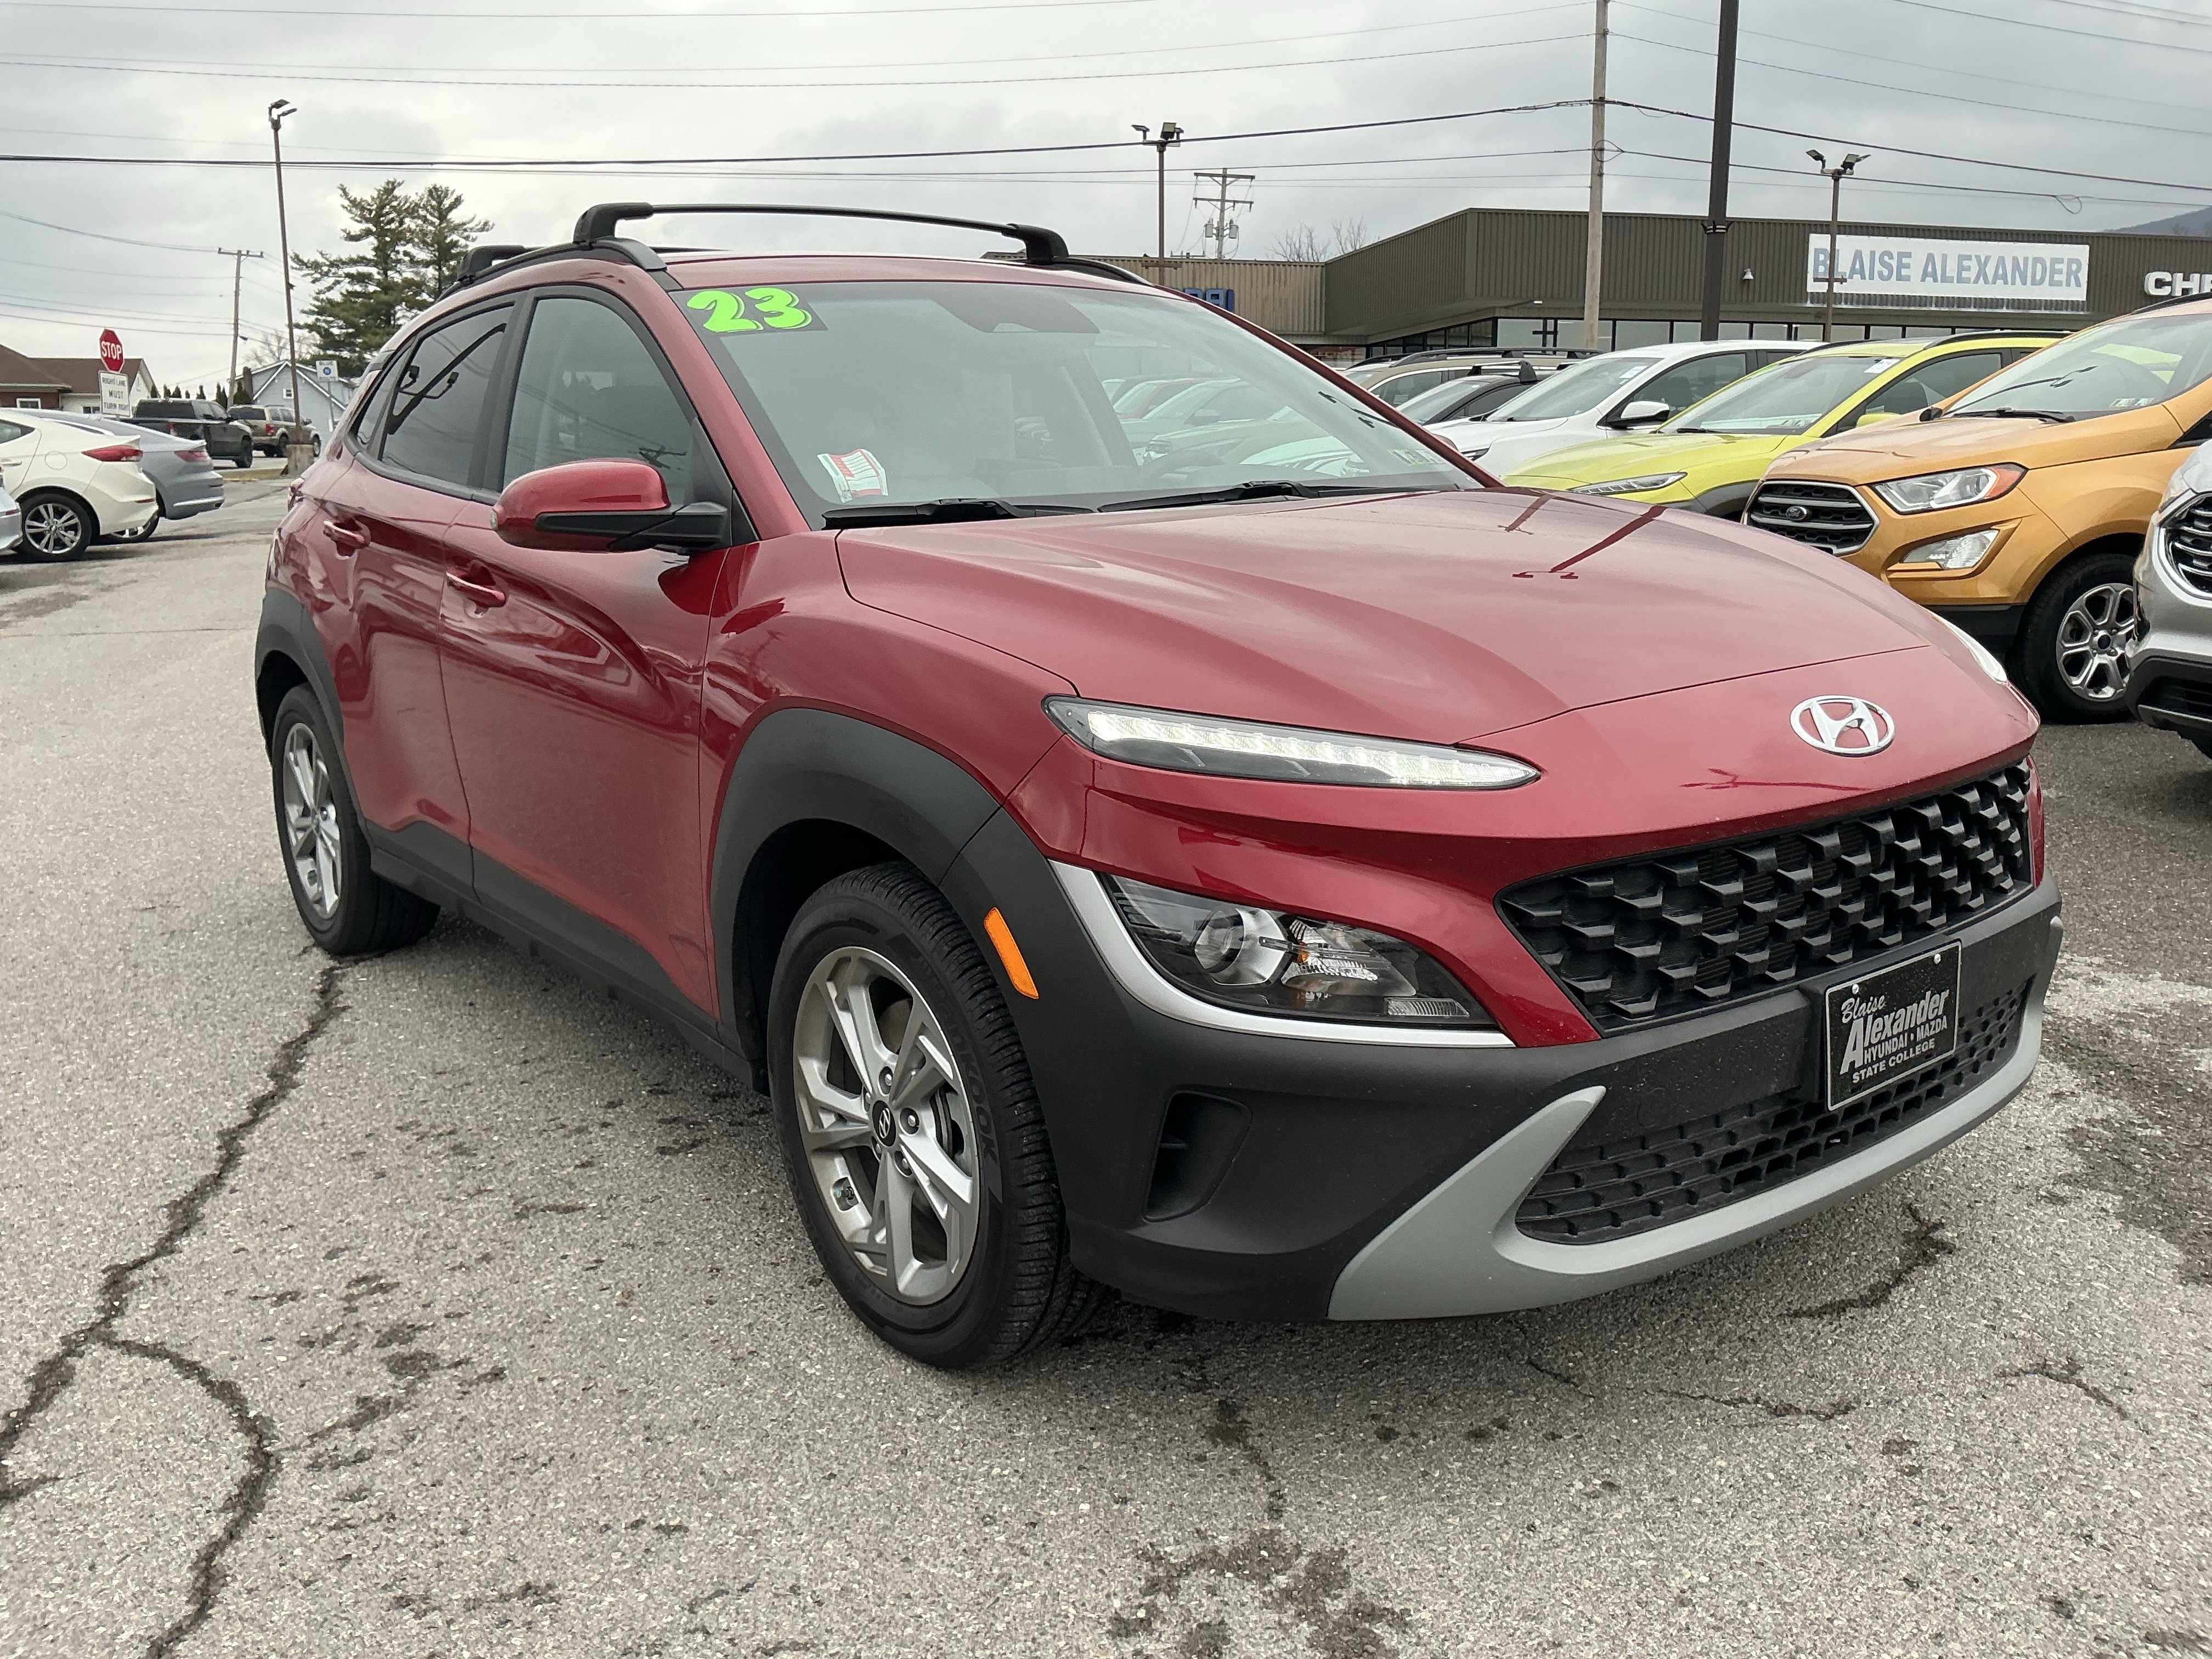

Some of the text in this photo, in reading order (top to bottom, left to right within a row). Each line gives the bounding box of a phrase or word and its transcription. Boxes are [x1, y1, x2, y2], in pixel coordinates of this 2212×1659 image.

[1813, 247, 2083, 287] BLAISE ALEXANDER
[686, 287, 812, 332] 23
[101, 341, 122, 360] STOP
[101, 377, 115, 385] RIGHT
[109, 389, 124, 399] MUST
[104, 401, 117, 410] TURN
[1841, 995, 1886, 1024] Blaise
[1839, 989, 1949, 1075] Alexander
[1864, 1015, 1948, 1065] HYUNDAI MAZDA
[1852, 1038, 1936, 1084] STATE COLLEGE
